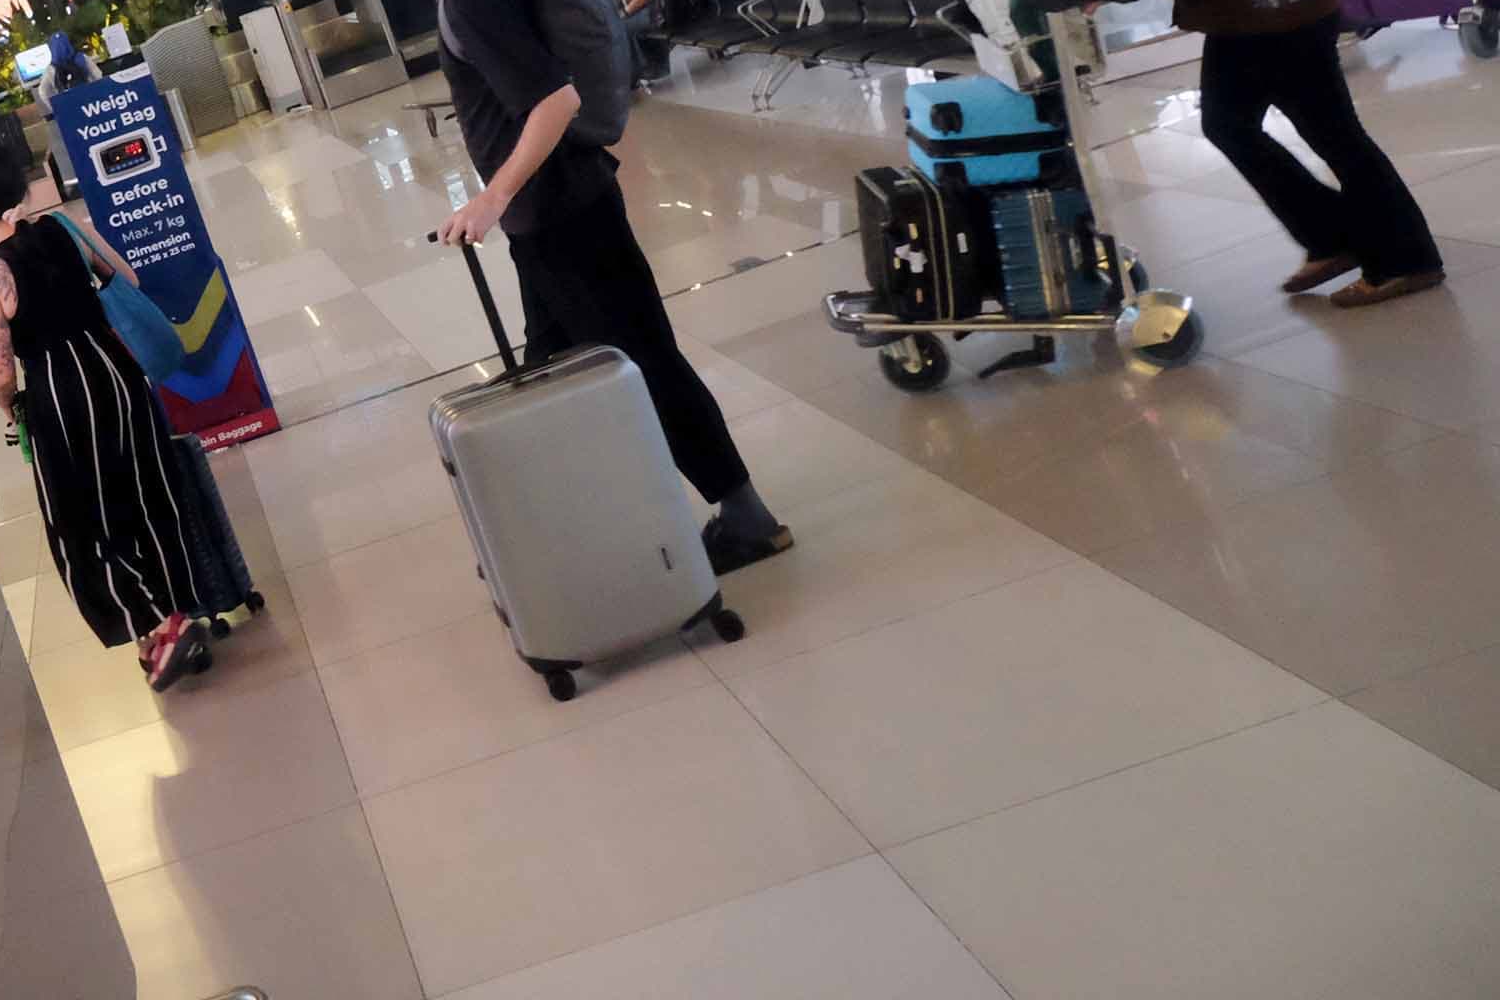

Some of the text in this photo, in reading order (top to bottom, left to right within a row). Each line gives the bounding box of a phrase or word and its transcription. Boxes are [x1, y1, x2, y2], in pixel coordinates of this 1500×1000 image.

[81, 89, 139, 118] Weigh
[76, 106, 156, 140] Your Bag
[111, 178, 169, 206] Before
[109, 193, 185, 227] Check-in
[122, 215, 185, 244] Max. 7 kg
[126, 232, 191, 260] Dimension
[180, 242, 196, 252] cm
[201, 421, 263, 447] bin Baggage
